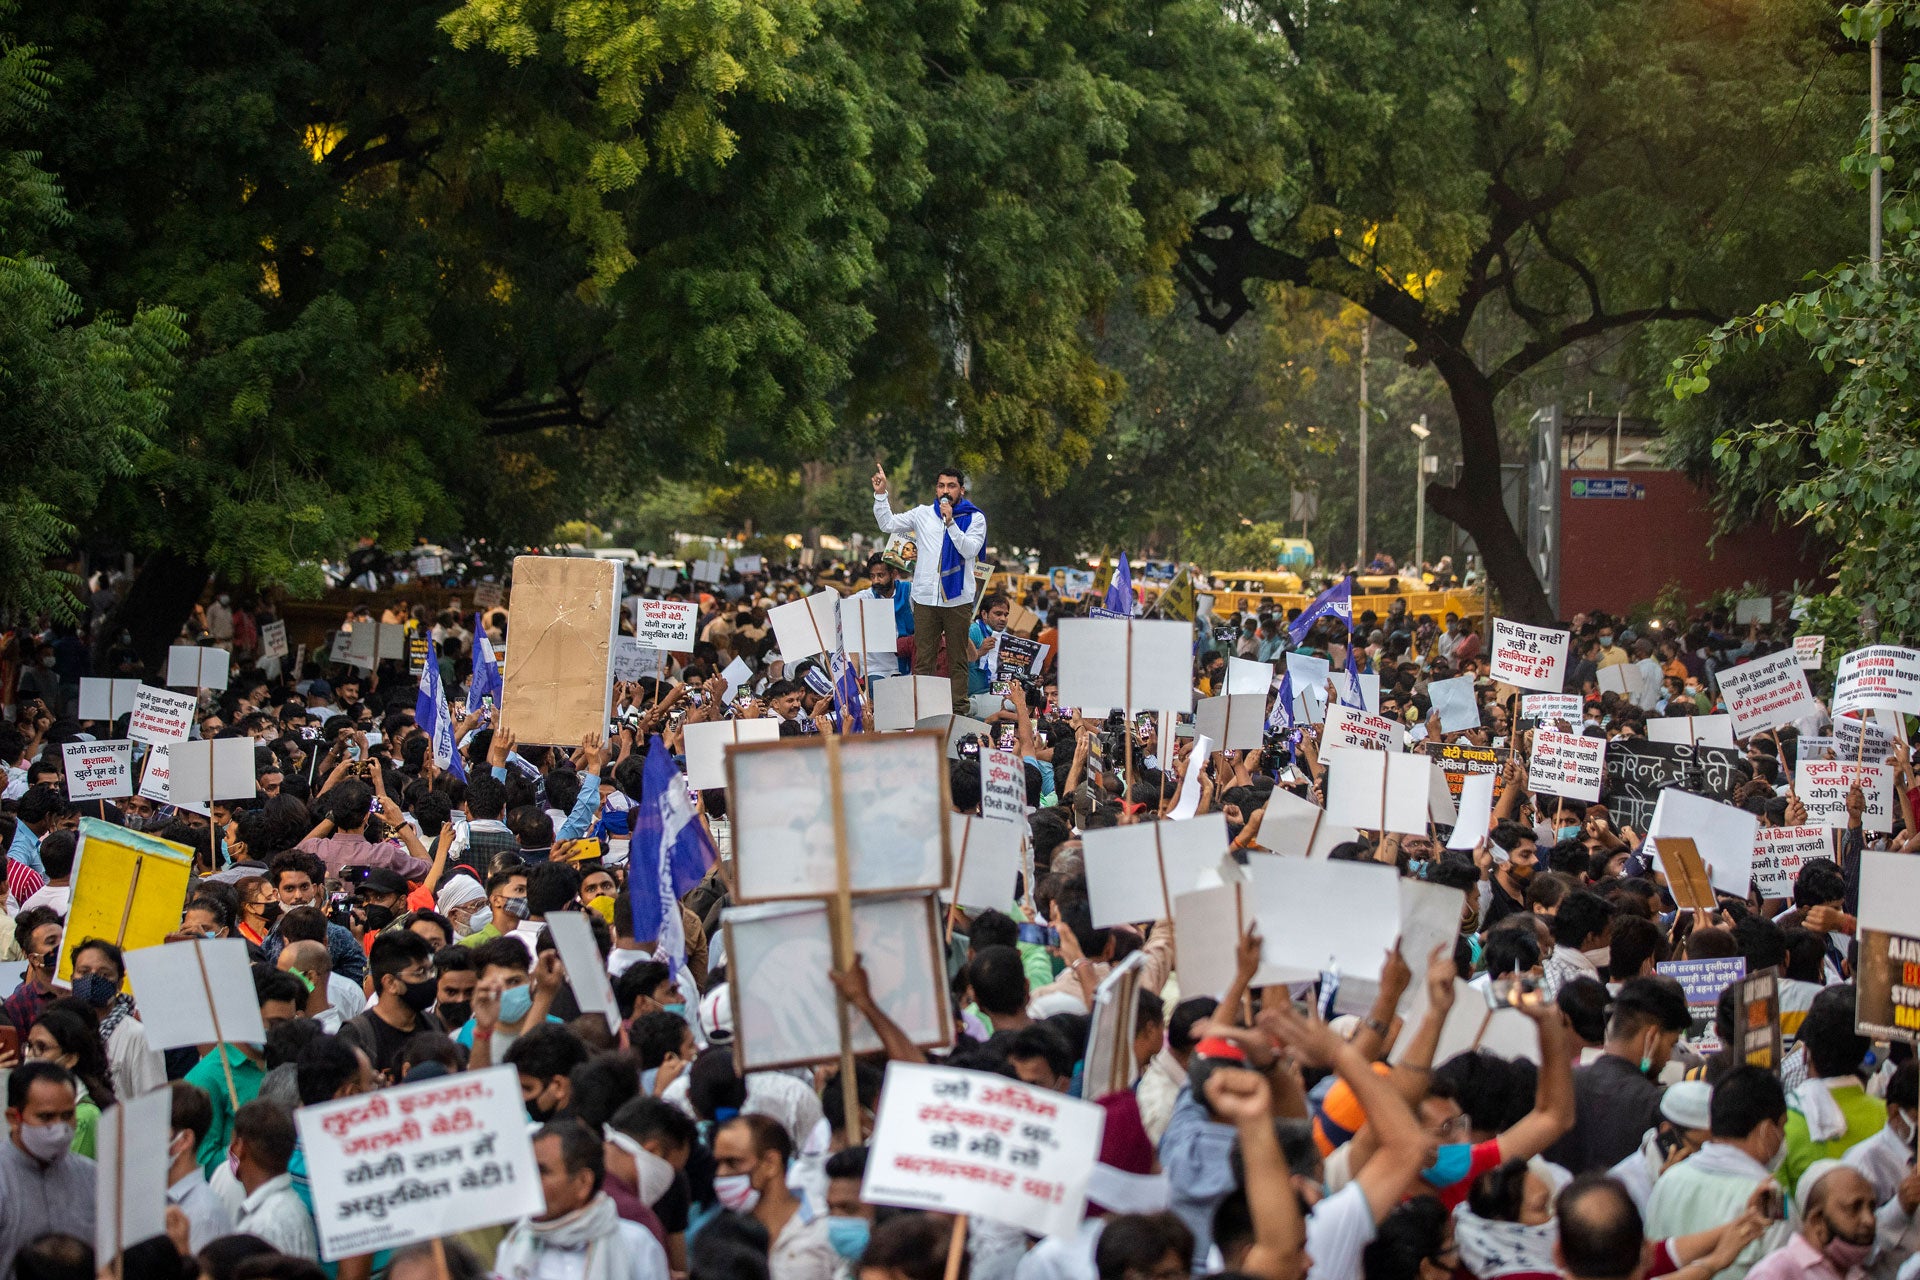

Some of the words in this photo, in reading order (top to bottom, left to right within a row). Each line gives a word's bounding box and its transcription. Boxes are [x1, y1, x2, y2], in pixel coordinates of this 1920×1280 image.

[643, 602, 660, 610] लुटती
[641, 630, 670, 640] असुरक्षित
[1497, 622, 1514, 634] सिर्फ
[1516, 627, 1537, 640] चिता
[1540, 633, 1564, 644] नहीं
[1508, 639, 1526, 650] जली
[1498, 648, 1537, 664] इंसानियत
[1540, 656, 1554, 666] भी
[1846, 656, 1856, 664] We
[1856, 649, 1870, 660] still
[1870, 648, 1916, 661] remember
[1857, 658, 1894, 669] NIRBHAYA
[1498, 661, 1512, 672] जल
[1515, 664, 1532, 676] गई
[1721, 676, 1739, 690] स्याही
[1740, 673, 1748, 682] भी
[1748, 670, 1762, 682] सुख
[1763, 662, 1776, 674] नहीं
[1777, 658, 1792, 669] पाती
[1838, 676, 1846, 686] We
[1864, 668, 1876, 676] let
[1877, 668, 1894, 677] you
[1858, 677, 1886, 687] GUDIYA
[1732, 701, 1744, 710] UP
[1745, 698, 1752, 706] से
[1752, 693, 1768, 704] खबर
[1768, 690, 1777, 699] आ
[1778, 682, 1796, 694] जाती
[1736, 684, 1752, 699] पुराने
[1737, 712, 1748, 722] एक
[1750, 707, 1762, 718] और
[1762, 698, 1792, 712] बलात्कार
[1346, 712, 1361, 722] जो
[1364, 716, 1392, 732] अंतिम
[1340, 722, 1378, 738] संस्कार
[1346, 735, 1358, 745] वो
[1564, 735, 1577, 746] किया
[1578, 737, 1598, 750] शिकार
[67, 744, 86, 755] योगी
[89, 744, 116, 753] सरकार
[1442, 746, 1460, 758] बेटी
[1538, 744, 1554, 757] पुलिस
[1556, 747, 1562, 756] ने
[1562, 750, 1575, 758] लाश
[1576, 752, 1598, 762] जलायी
[74, 766, 92, 780] खुले
[94, 768, 106, 778] घूम
[108, 766, 116, 775] रहे
[1436, 759, 1466, 770] लेकिन
[1468, 761, 1504, 774] किससे?
[1563, 761, 1577, 771] योगी
[1578, 764, 1600, 775] सरकार
[1806, 762, 1836, 775] लुटती
[1530, 767, 1544, 778] जिसे
[1558, 772, 1564, 782] भी
[1584, 777, 1600, 788] आयी
[1812, 776, 1848, 786] जलती
[1810, 788, 1838, 798] योगी
[1868, 792, 1880, 801] में
[1804, 802, 1848, 815] असुरक्षि
[1764, 830, 1772, 840] ने
[1774, 829, 1792, 840] किया
[1795, 827, 1822, 838] शिकार
[1768, 844, 1774, 854] ने
[1777, 844, 1794, 854] लाश
[1796, 839, 1824, 852] जलायी
[1782, 855, 1800, 866] योगी
[1760, 874, 1776, 882] जरा
[1778, 870, 1786, 880] भी
[1660, 964, 1676, 974] योगी
[1678, 963, 1703, 972] सरकार
[1705, 961, 1733, 972] इस्तीफा
[1734, 960, 1742, 970] दो
[1700, 972, 1715, 982] नहीं
[1717, 971, 1737, 980] चलेगी
[1696, 985, 1713, 994] बहन
[932, 1078, 972, 1101] जो
[978, 1085, 1058, 1118] अंतिम
[322, 1093, 390, 1136] लुटती
[918, 1103, 1014, 1134] संस्कार
[342, 1118, 422, 1156] जलती
[930, 1126, 961, 1150] वो
[968, 1131, 1003, 1158] भी
[1009, 1146, 1042, 1169] तो
[344, 1151, 405, 1184] योगी
[412, 1146, 464, 1170] राज
[470, 1130, 498, 1157] में
[892, 1153, 1017, 1190] बलात्कार
[336, 1178, 452, 1220] असुरक्षित
[458, 1160, 516, 1190] बेटी!
